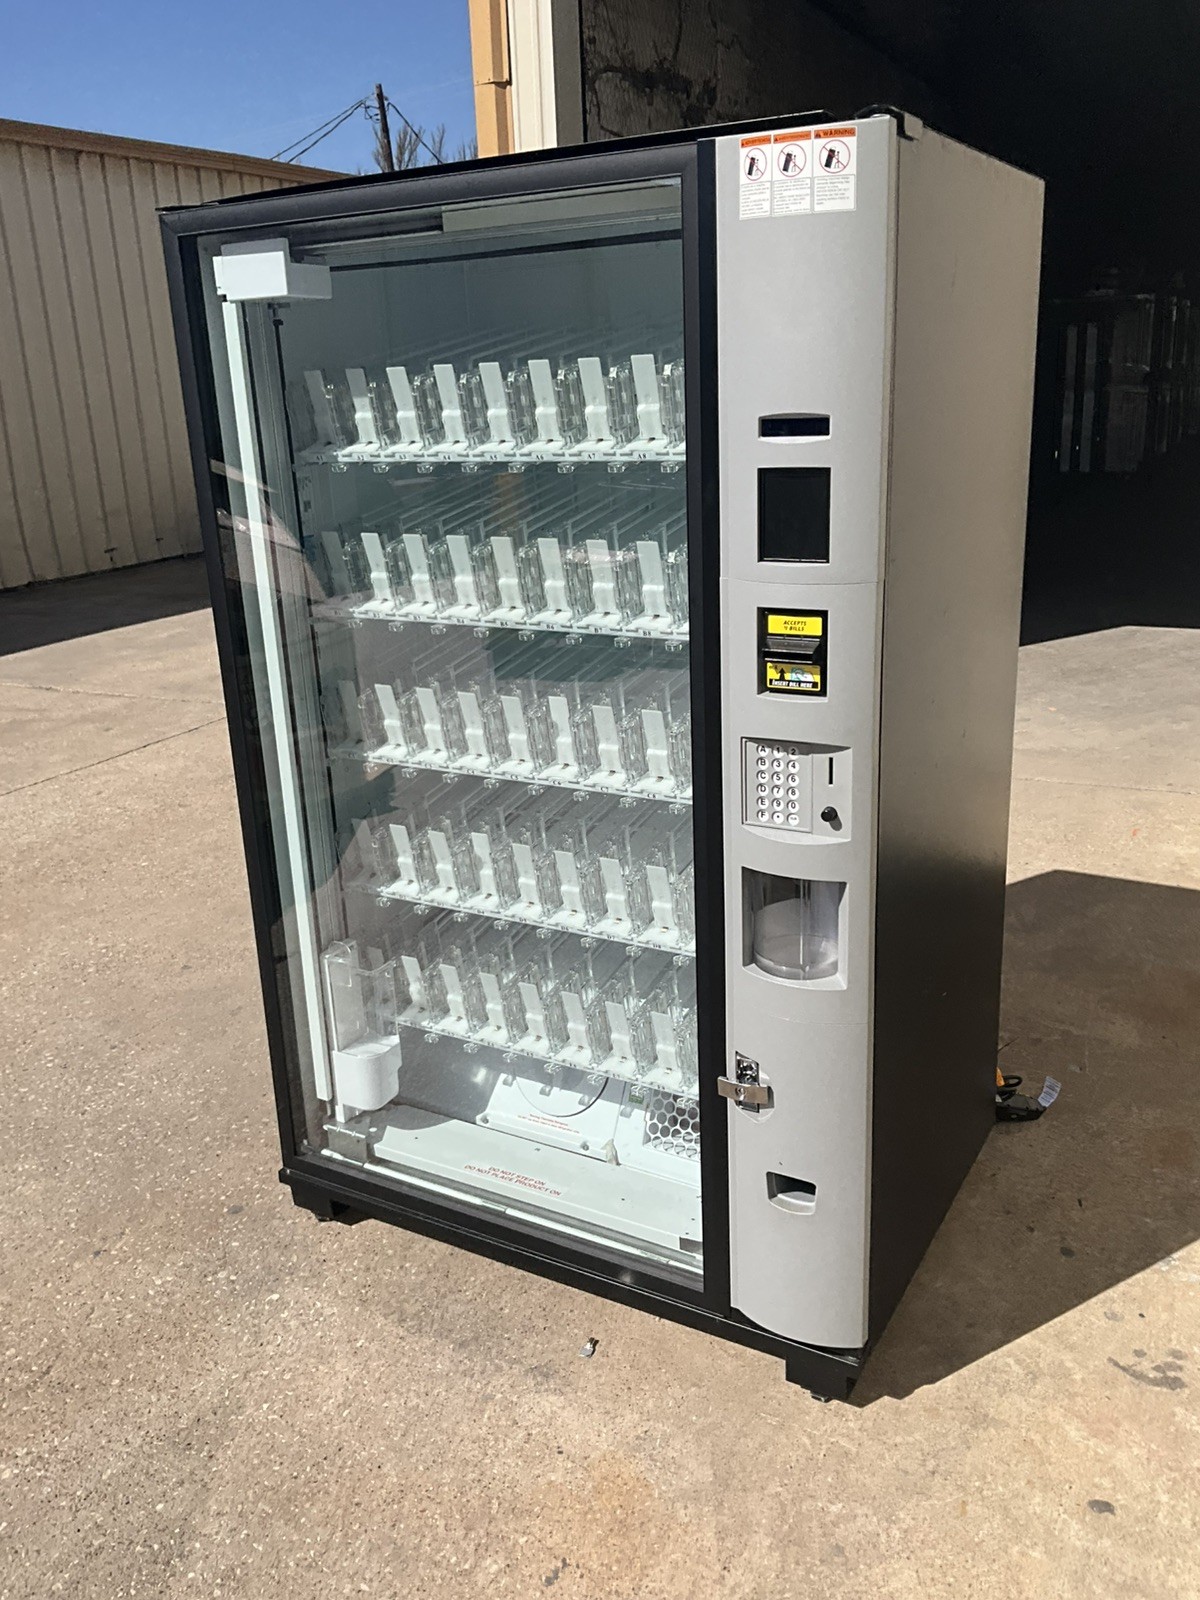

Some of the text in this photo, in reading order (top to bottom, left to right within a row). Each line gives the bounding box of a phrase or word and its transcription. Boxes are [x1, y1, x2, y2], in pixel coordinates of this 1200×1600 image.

[823, 127, 855, 136] WARNING
[492, 1172, 514, 1182] PLACE
[515, 1179, 548, 1192] PRODUCT
[516, 1174, 534, 1182] STEP
